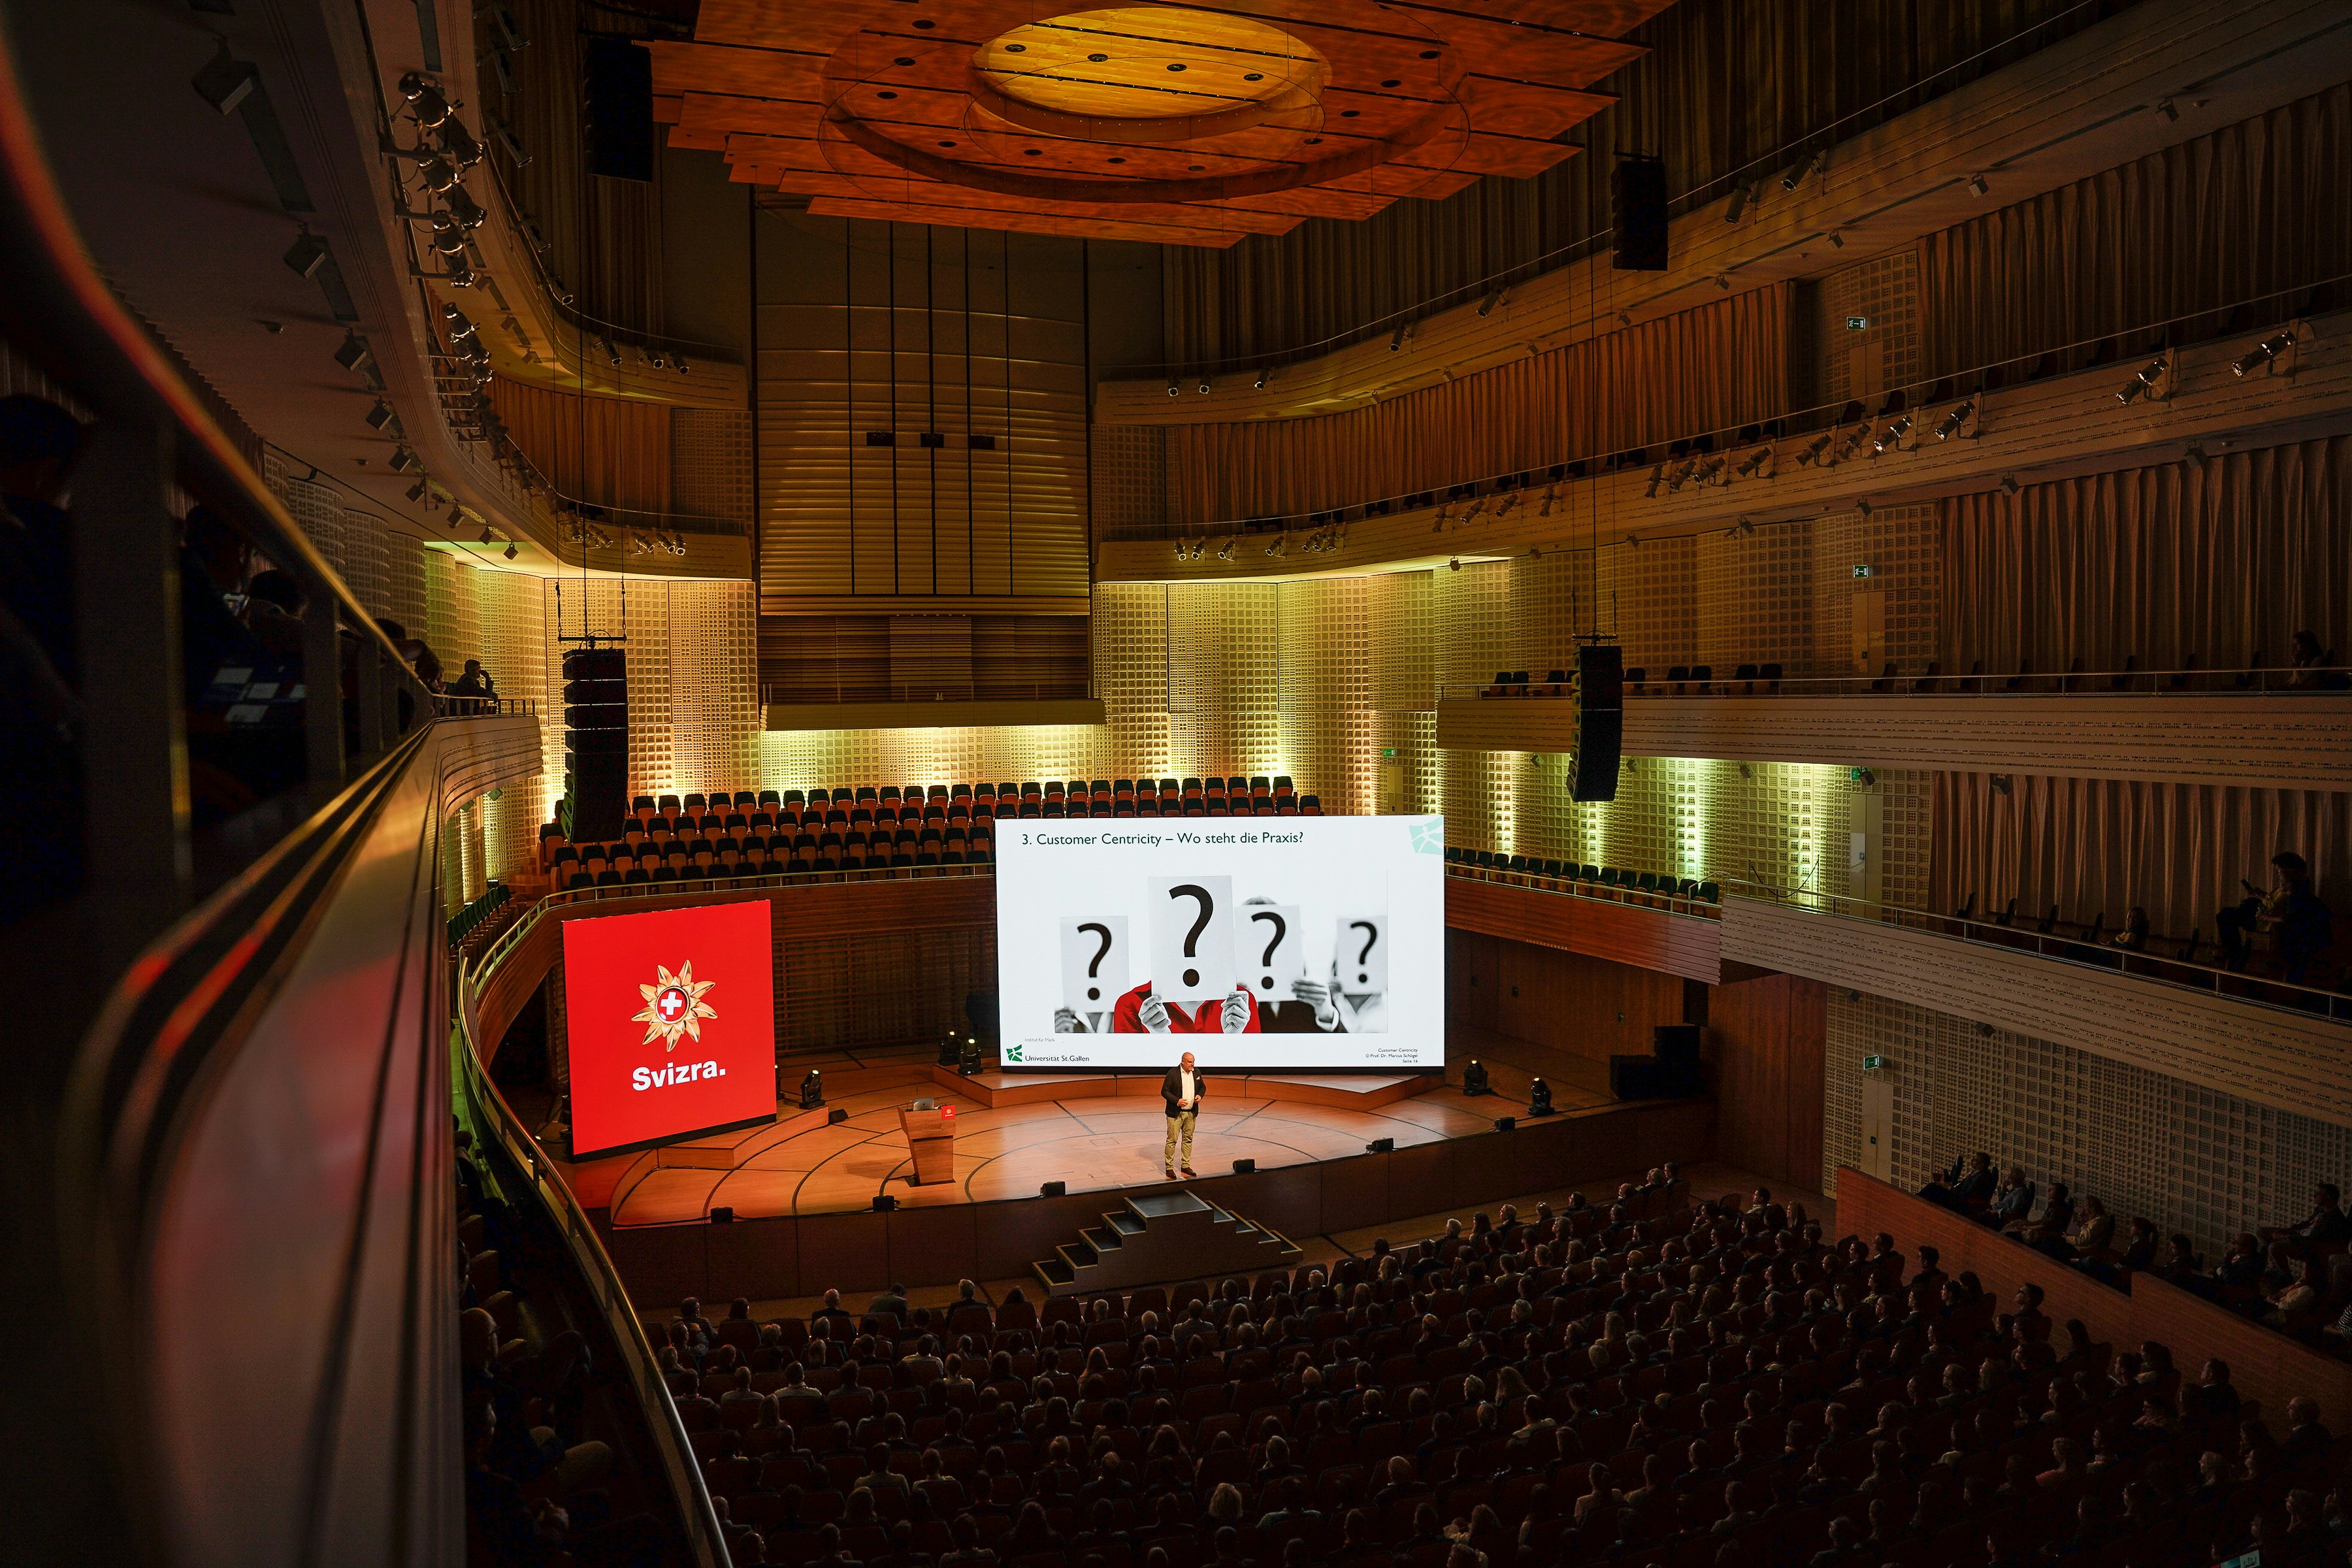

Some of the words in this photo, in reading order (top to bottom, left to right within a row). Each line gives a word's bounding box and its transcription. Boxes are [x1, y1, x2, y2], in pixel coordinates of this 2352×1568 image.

[1022, 834, 1032, 845] 3.
[1036, 834, 1098, 845] Customer
[1102, 833, 1162, 847] Centricity
[1177, 832, 1201, 844] Wo
[1205, 832, 1236, 844] steht
[1240, 832, 1258, 843] die
[1262, 831, 1303, 843] Praxis?
[1168, 884, 1214, 988] ?
[632, 1060, 726, 1091] Svizra.
